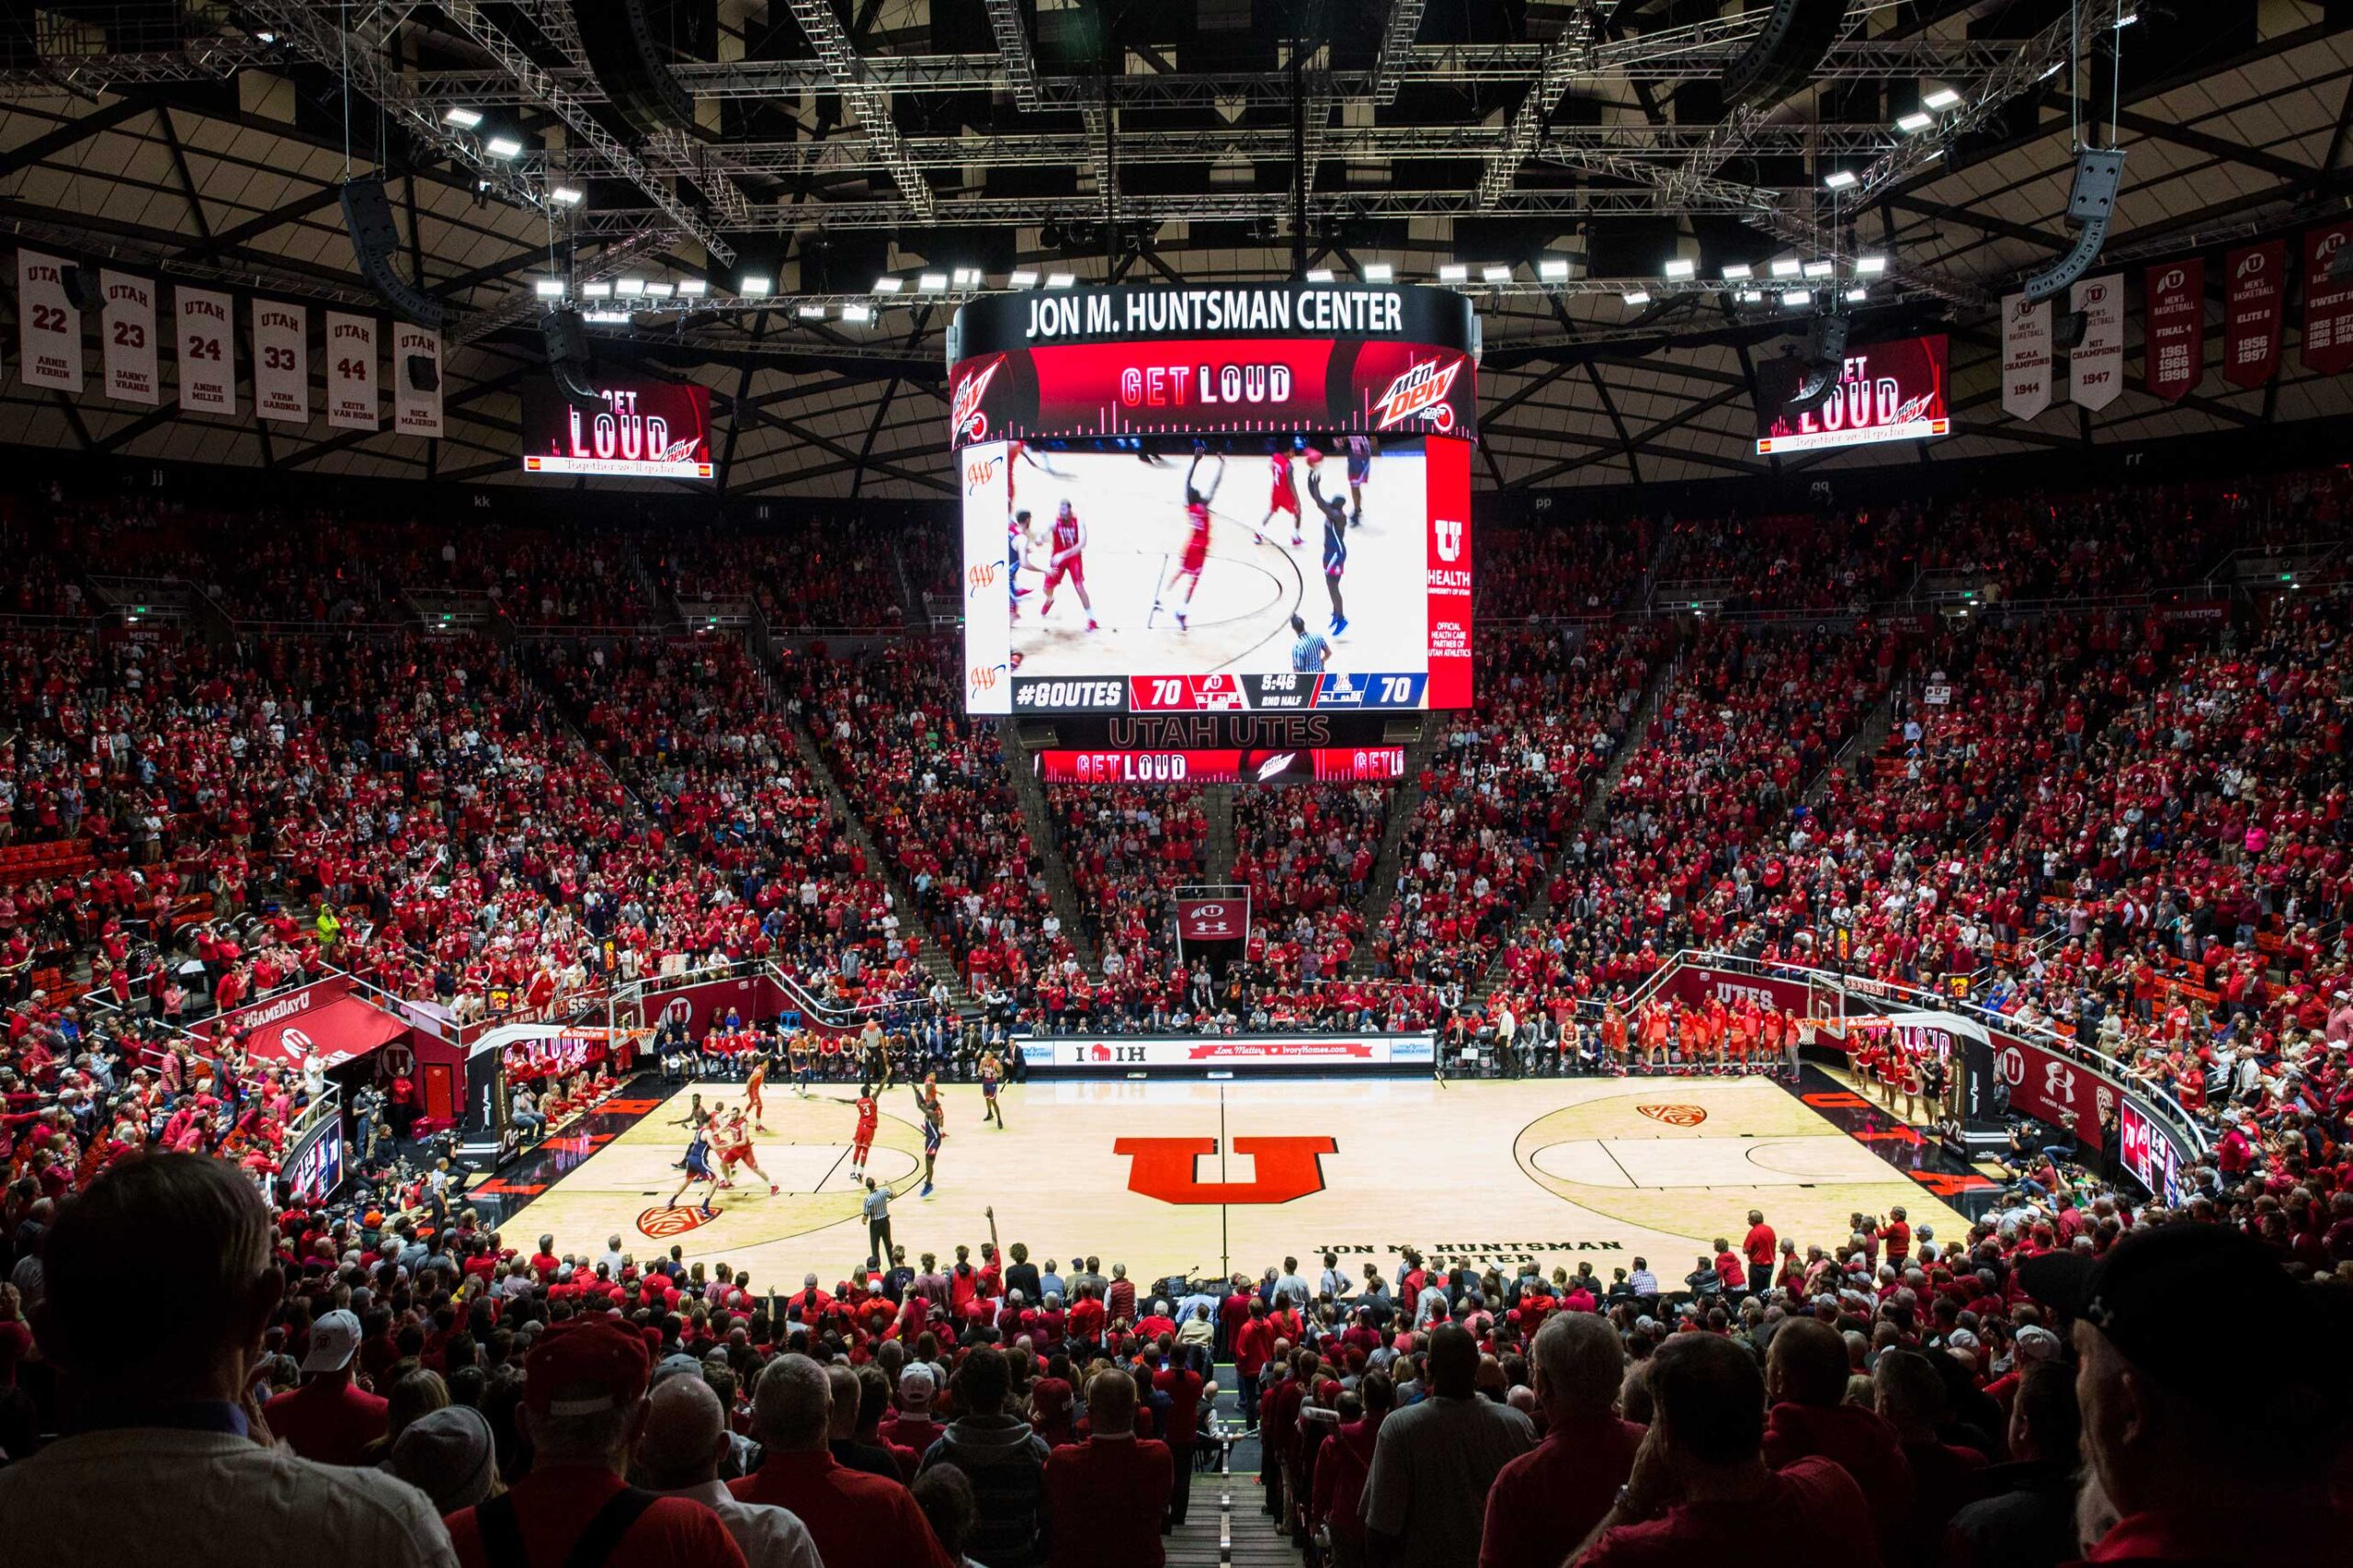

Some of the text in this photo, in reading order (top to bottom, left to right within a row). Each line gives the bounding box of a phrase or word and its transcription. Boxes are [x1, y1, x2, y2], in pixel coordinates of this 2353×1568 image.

[28, 266, 60, 284] UTA
[109, 285, 148, 307] UTAH
[2234, 286, 2276, 301] BASKETBALL
[2310, 292, 2345, 308] SWEET
[185, 301, 225, 321] UTAH
[1026, 289, 1402, 338] JON M. HUNTSMAN CENTER
[2154, 301, 2195, 316] BASKETBALL
[32, 304, 66, 334] 22
[261, 312, 299, 333] UTAH
[2088, 316, 2115, 327] KETBALL
[2236, 309, 2270, 324] ELITE 8
[2155, 324, 2192, 337] FINAL 4
[2310, 319, 2331, 331] 1955
[114, 321, 144, 348] 23
[335, 324, 369, 344] UTAH
[2009, 329, 2044, 341] BASKETBALL
[2309, 328, 2331, 340] 1959
[189, 335, 222, 361] 24
[402, 335, 436, 353] UTAH
[2089, 339, 2104, 348] NIT
[2238, 335, 2268, 352] 1956
[2309, 337, 2331, 350] 1960
[2016, 350, 2038, 359] NCAA
[2072, 346, 2121, 359] CHAMPIONS
[2160, 344, 2188, 358] 1961
[2237, 347, 2268, 364] 1997
[38, 356, 67, 368] ARNIE
[265, 346, 295, 371] 33
[2005, 358, 2050, 371] CHAMPIONS
[2159, 356, 2189, 370] 1966
[36, 367, 70, 379] FERRIN
[116, 369, 148, 382] DANNY
[337, 358, 366, 381] 44
[1838, 356, 1868, 382] ET
[2158, 368, 2189, 382] 1998
[115, 379, 150, 392] VRANES
[1121, 365, 1290, 405] GET LOUD
[2083, 372, 2109, 385] 1947
[193, 382, 222, 394] ANDRE
[2014, 382, 2040, 395] 1944
[192, 391, 223, 403] MILLER
[271, 392, 294, 402] VERN
[263, 400, 301, 413] GARDNER
[341, 401, 365, 412] KEITH
[410, 409, 428, 418] RICK
[334, 409, 374, 420] VAN HORN
[401, 417, 438, 428] MAJERUS
[571, 412, 667, 460] LOUD
[2125, 452, 2143, 467] rr
[473, 494, 491, 509] kk
[1535, 497, 1552, 511] pp
[1435, 520, 1461, 562] U
[1427, 570, 1471, 587] HEALTH
[1437, 622, 1461, 631] OFFICIAL
[1431, 631, 1466, 640] HEALTH CARE
[1433, 640, 1456, 648] PARTNER
[1444, 649, 1471, 657] ATHLETICS
[1017, 682, 1121, 707] #GOUTES
[1151, 680, 1182, 705] 70
[1381, 677, 1411, 702] 70
[1280, 696, 1302, 706] HALF
[1109, 715, 1330, 749] UTAH UTES
[1077, 754, 1186, 780] GET LOUD
[1354, 751, 1389, 778] GET
[1076, 1047, 1085, 1062] I
[1214, 1045, 1347, 1056] Love Matters IvoryHomes.com
[863, 1105, 871, 1116] 3
[1113, 1136, 1339, 1204] U
[1313, 1244, 1375, 1254] JON
[1434, 1241, 1623, 1254] HUNTSMAN
